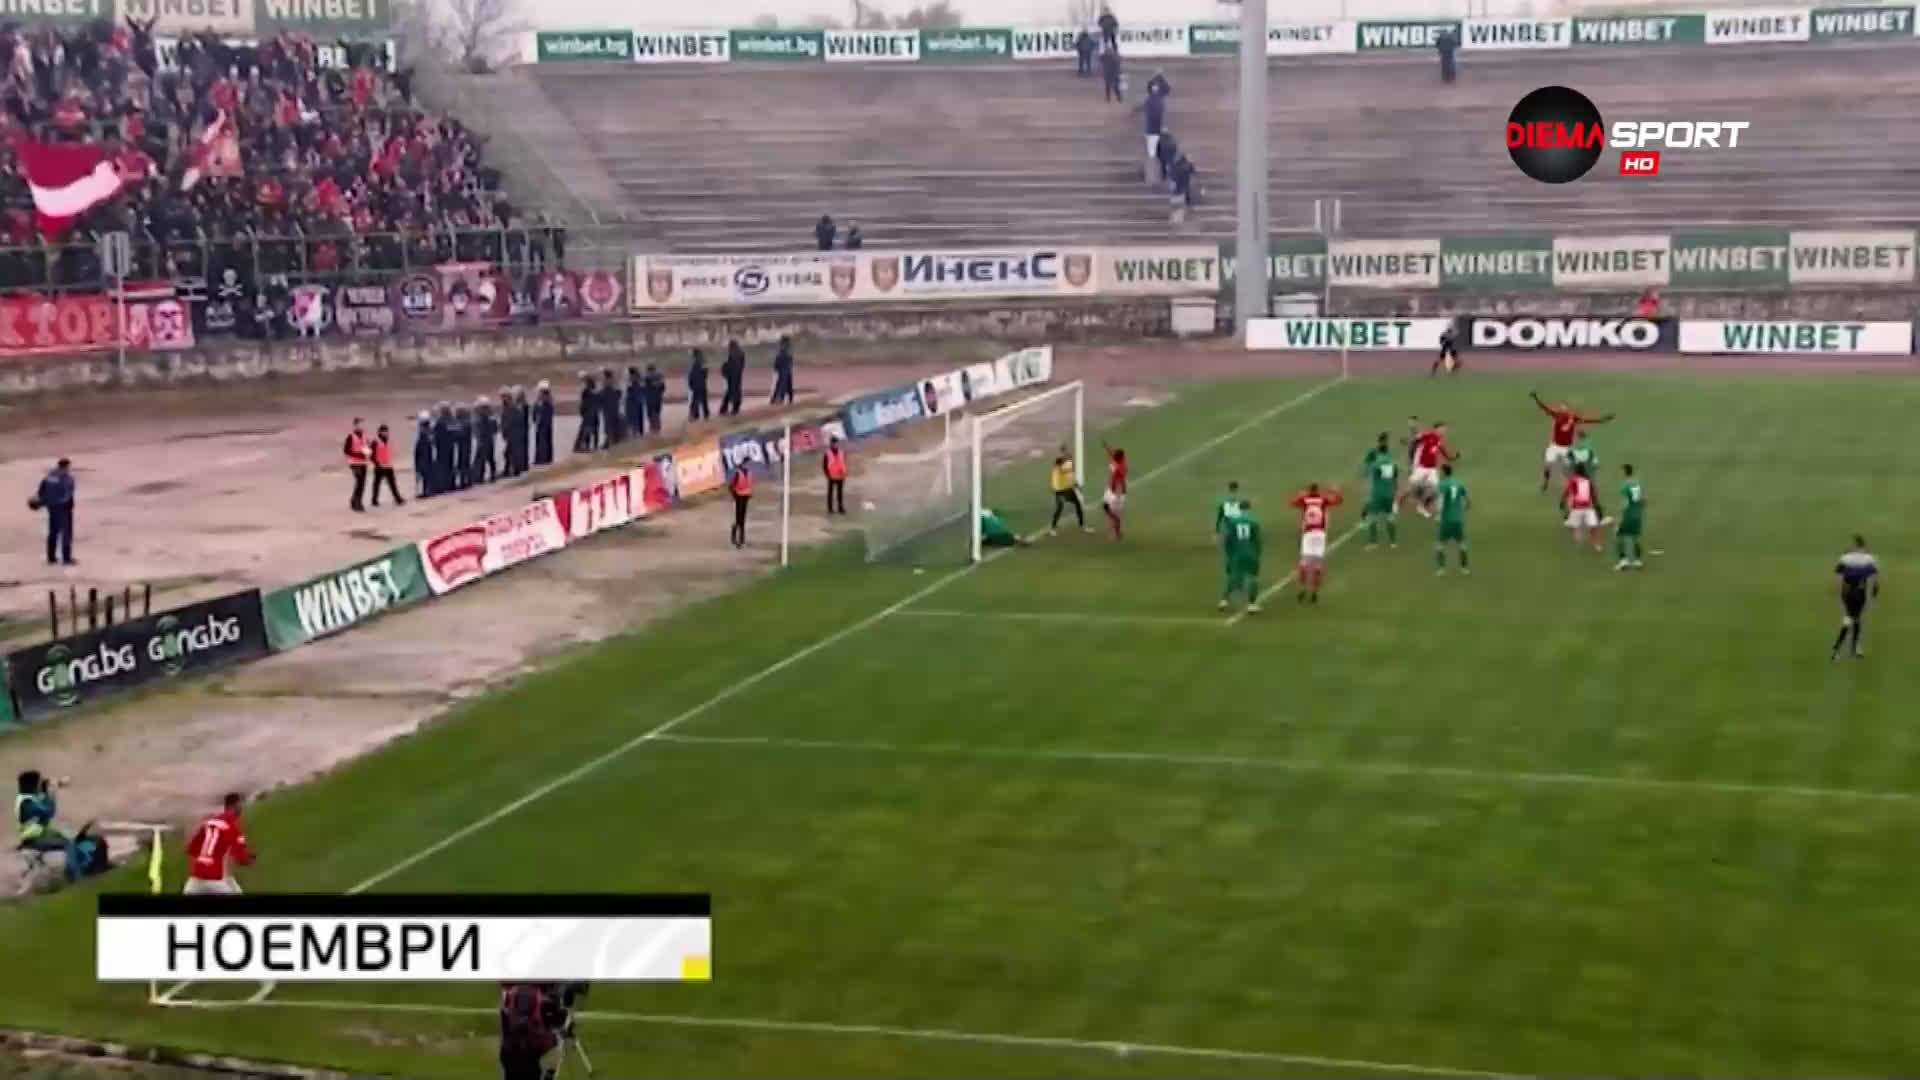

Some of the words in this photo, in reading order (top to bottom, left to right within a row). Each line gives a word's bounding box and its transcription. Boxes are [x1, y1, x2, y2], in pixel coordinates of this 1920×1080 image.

[1468, 23, 1567, 45] WINBET
[1578, 19, 1677, 42] WINBET
[1713, 15, 1801, 37] WINBET
[1816, 11, 1910, 34] WINBET
[637, 35, 728, 57] WINBET
[828, 34, 916, 57] WINBET
[1015, 31, 1073, 52] WINB
[1114, 257, 1216, 282] WINBET
[1332, 253, 1435, 276] WINBET
[1442, 249, 1549, 275] WINBET
[1558, 248, 1666, 273] WINBET
[1673, 246, 1786, 271] WINBET
[1794, 244, 1911, 270] WINBET
[1285, 321, 1412, 347] WINBET
[1471, 320, 1660, 349] DOMKO
[1723, 324, 1867, 350] WINBET
[294, 559, 403, 635] WINBET
